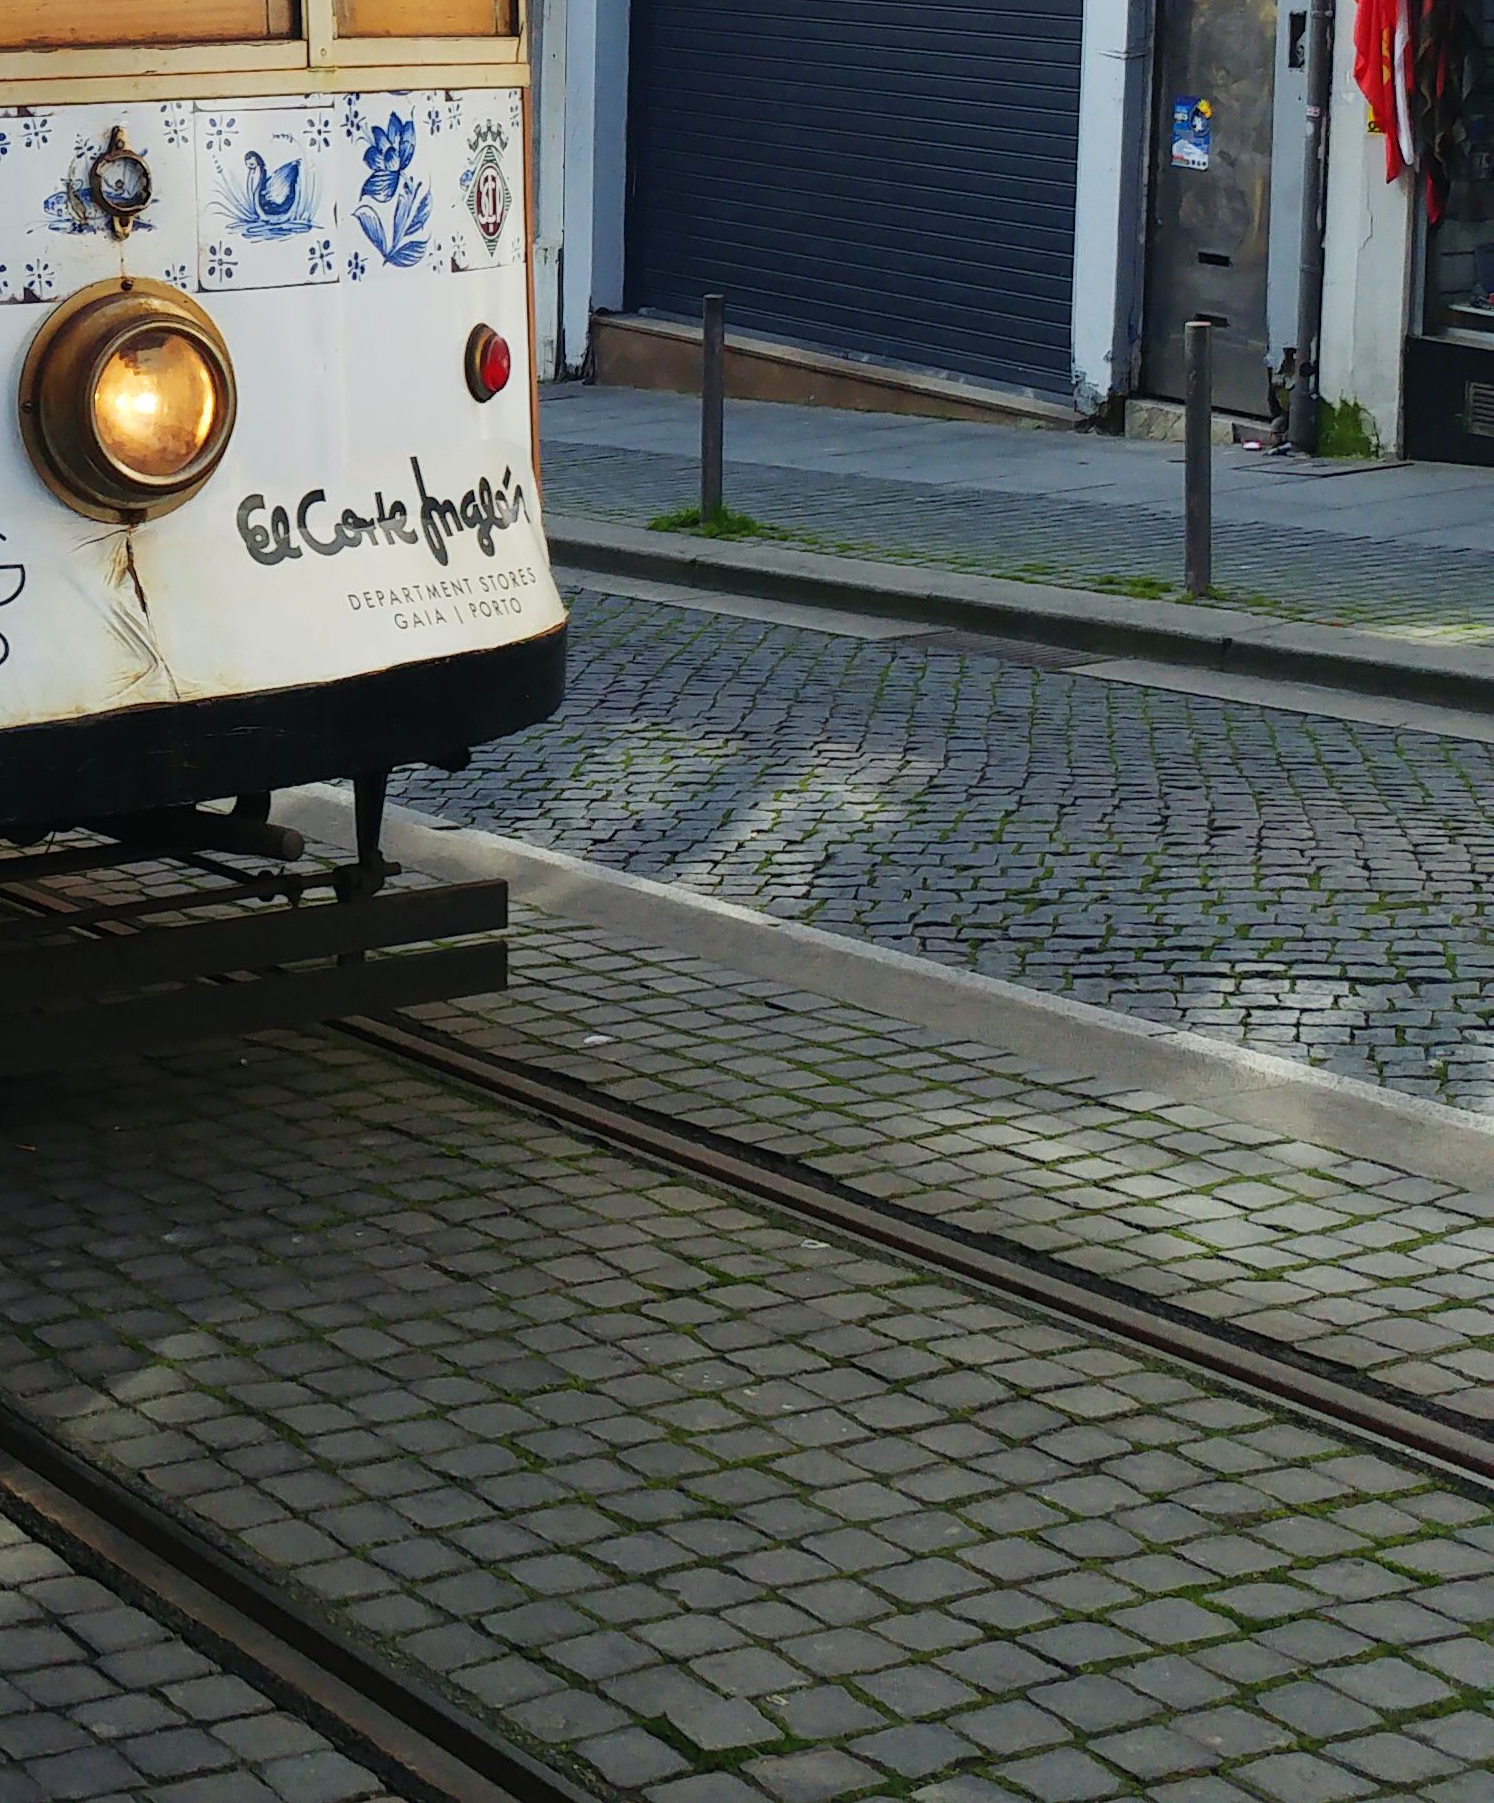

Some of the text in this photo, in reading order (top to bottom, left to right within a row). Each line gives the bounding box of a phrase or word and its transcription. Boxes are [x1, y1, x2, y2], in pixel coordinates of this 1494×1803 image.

[236, 456, 531, 567] El Corte Inglés
[347, 566, 537, 611] DEPARTMENT STORES
[394, 608, 448, 630] GAIA
[469, 596, 523, 619] PORTO
